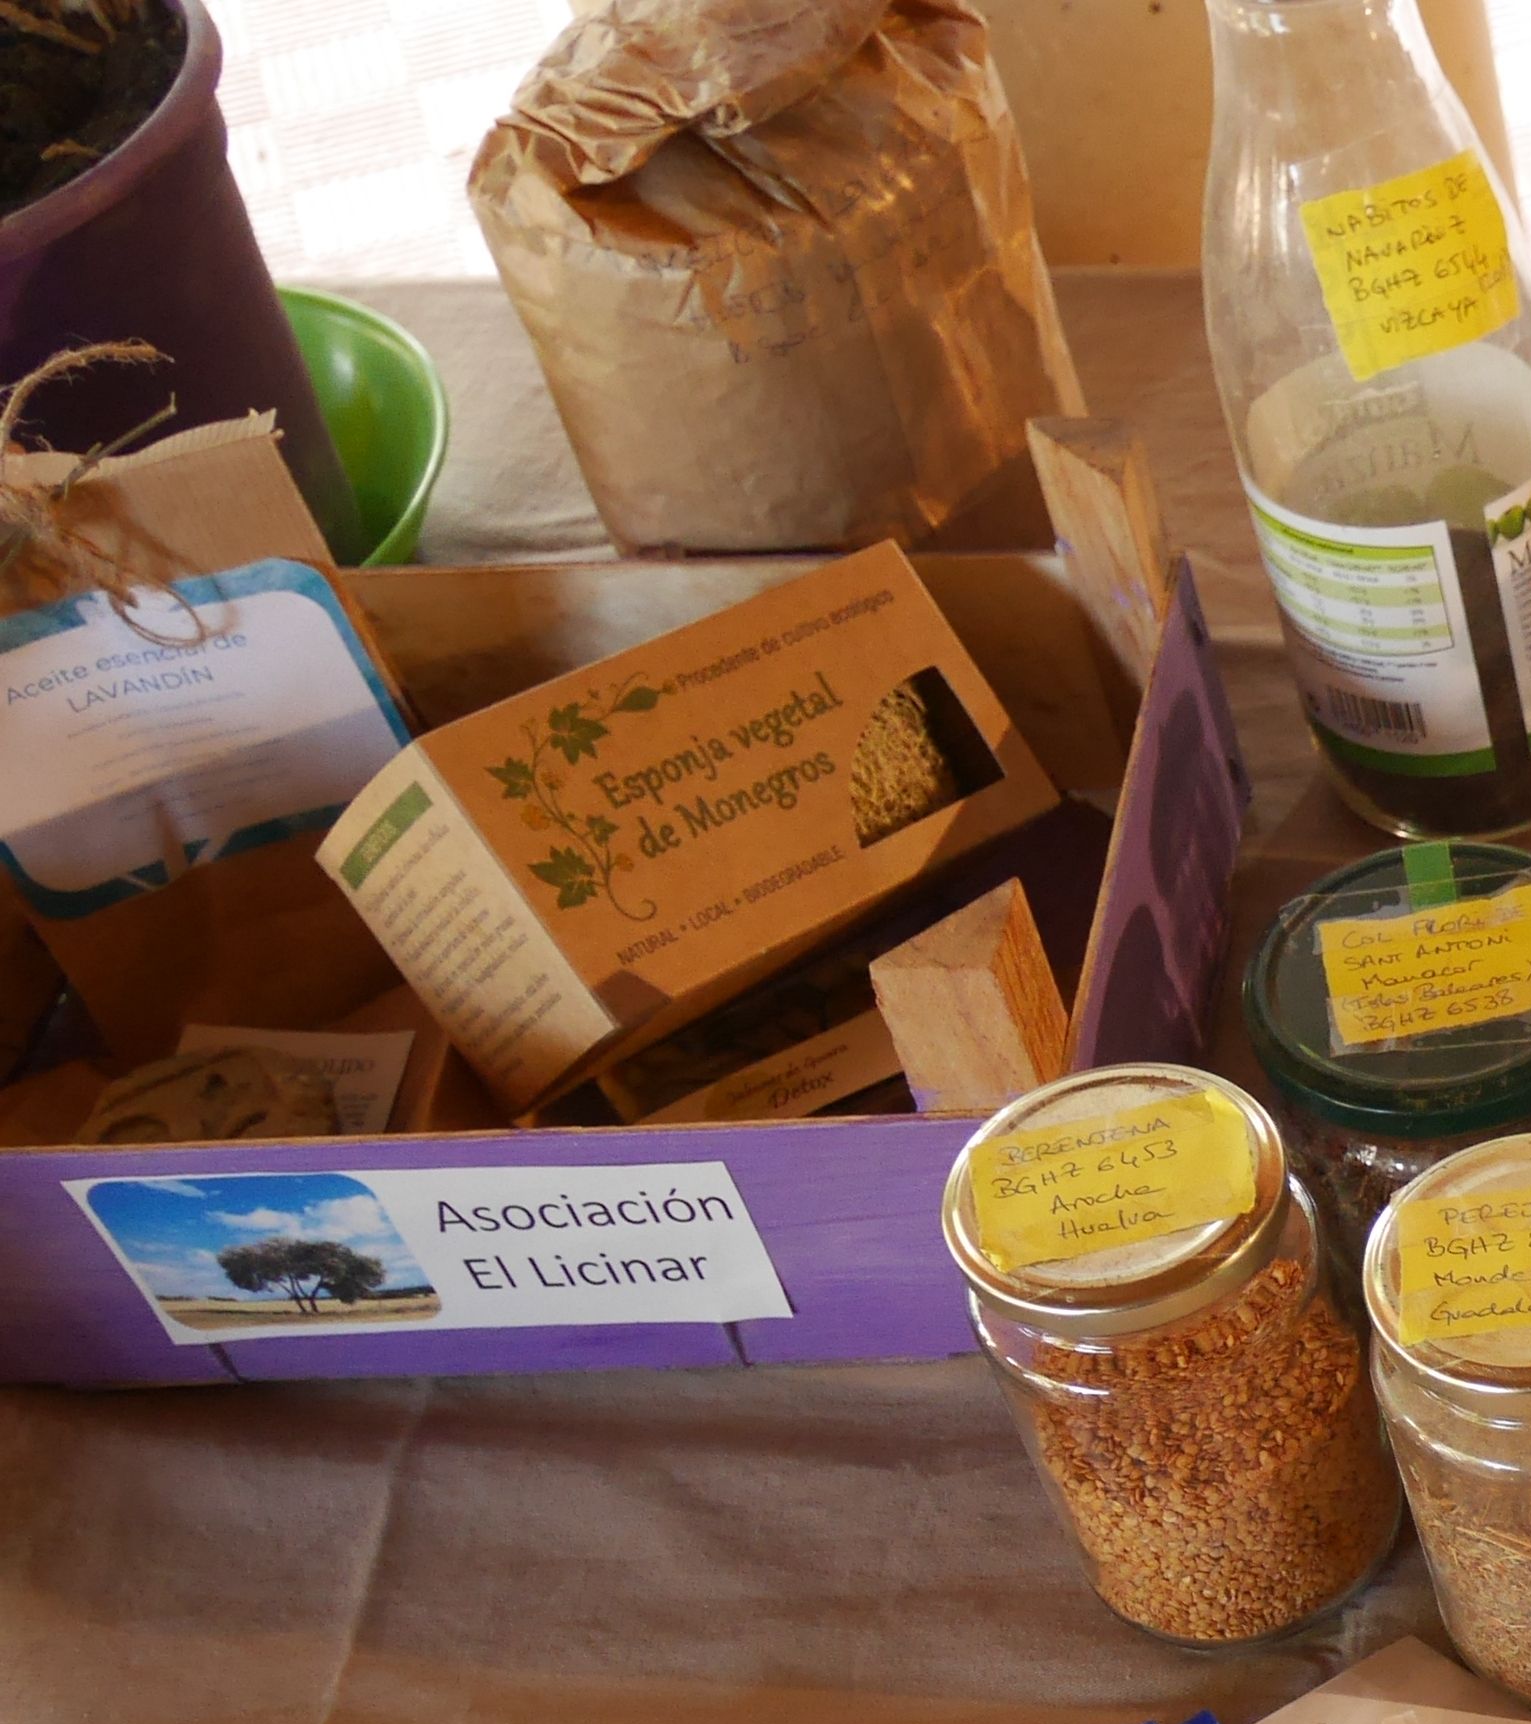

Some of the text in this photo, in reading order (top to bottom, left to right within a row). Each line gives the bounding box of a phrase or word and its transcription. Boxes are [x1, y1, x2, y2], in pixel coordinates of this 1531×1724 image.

[5, 664, 89, 705] Aceite
[213, 632, 247, 650] de
[65, 665, 214, 713] LAVANDÍN
[675, 645, 760, 693] Procedente
[760, 636, 781, 657] de
[591, 670, 844, 810] Esponja vegetal
[637, 751, 837, 859] de Monegros
[615, 844, 847, 966] NATURAL LOCAL BIODEGRADABLE
[437, 1187, 735, 1234] Asociación
[466, 1247, 709, 1292] El Licinar
